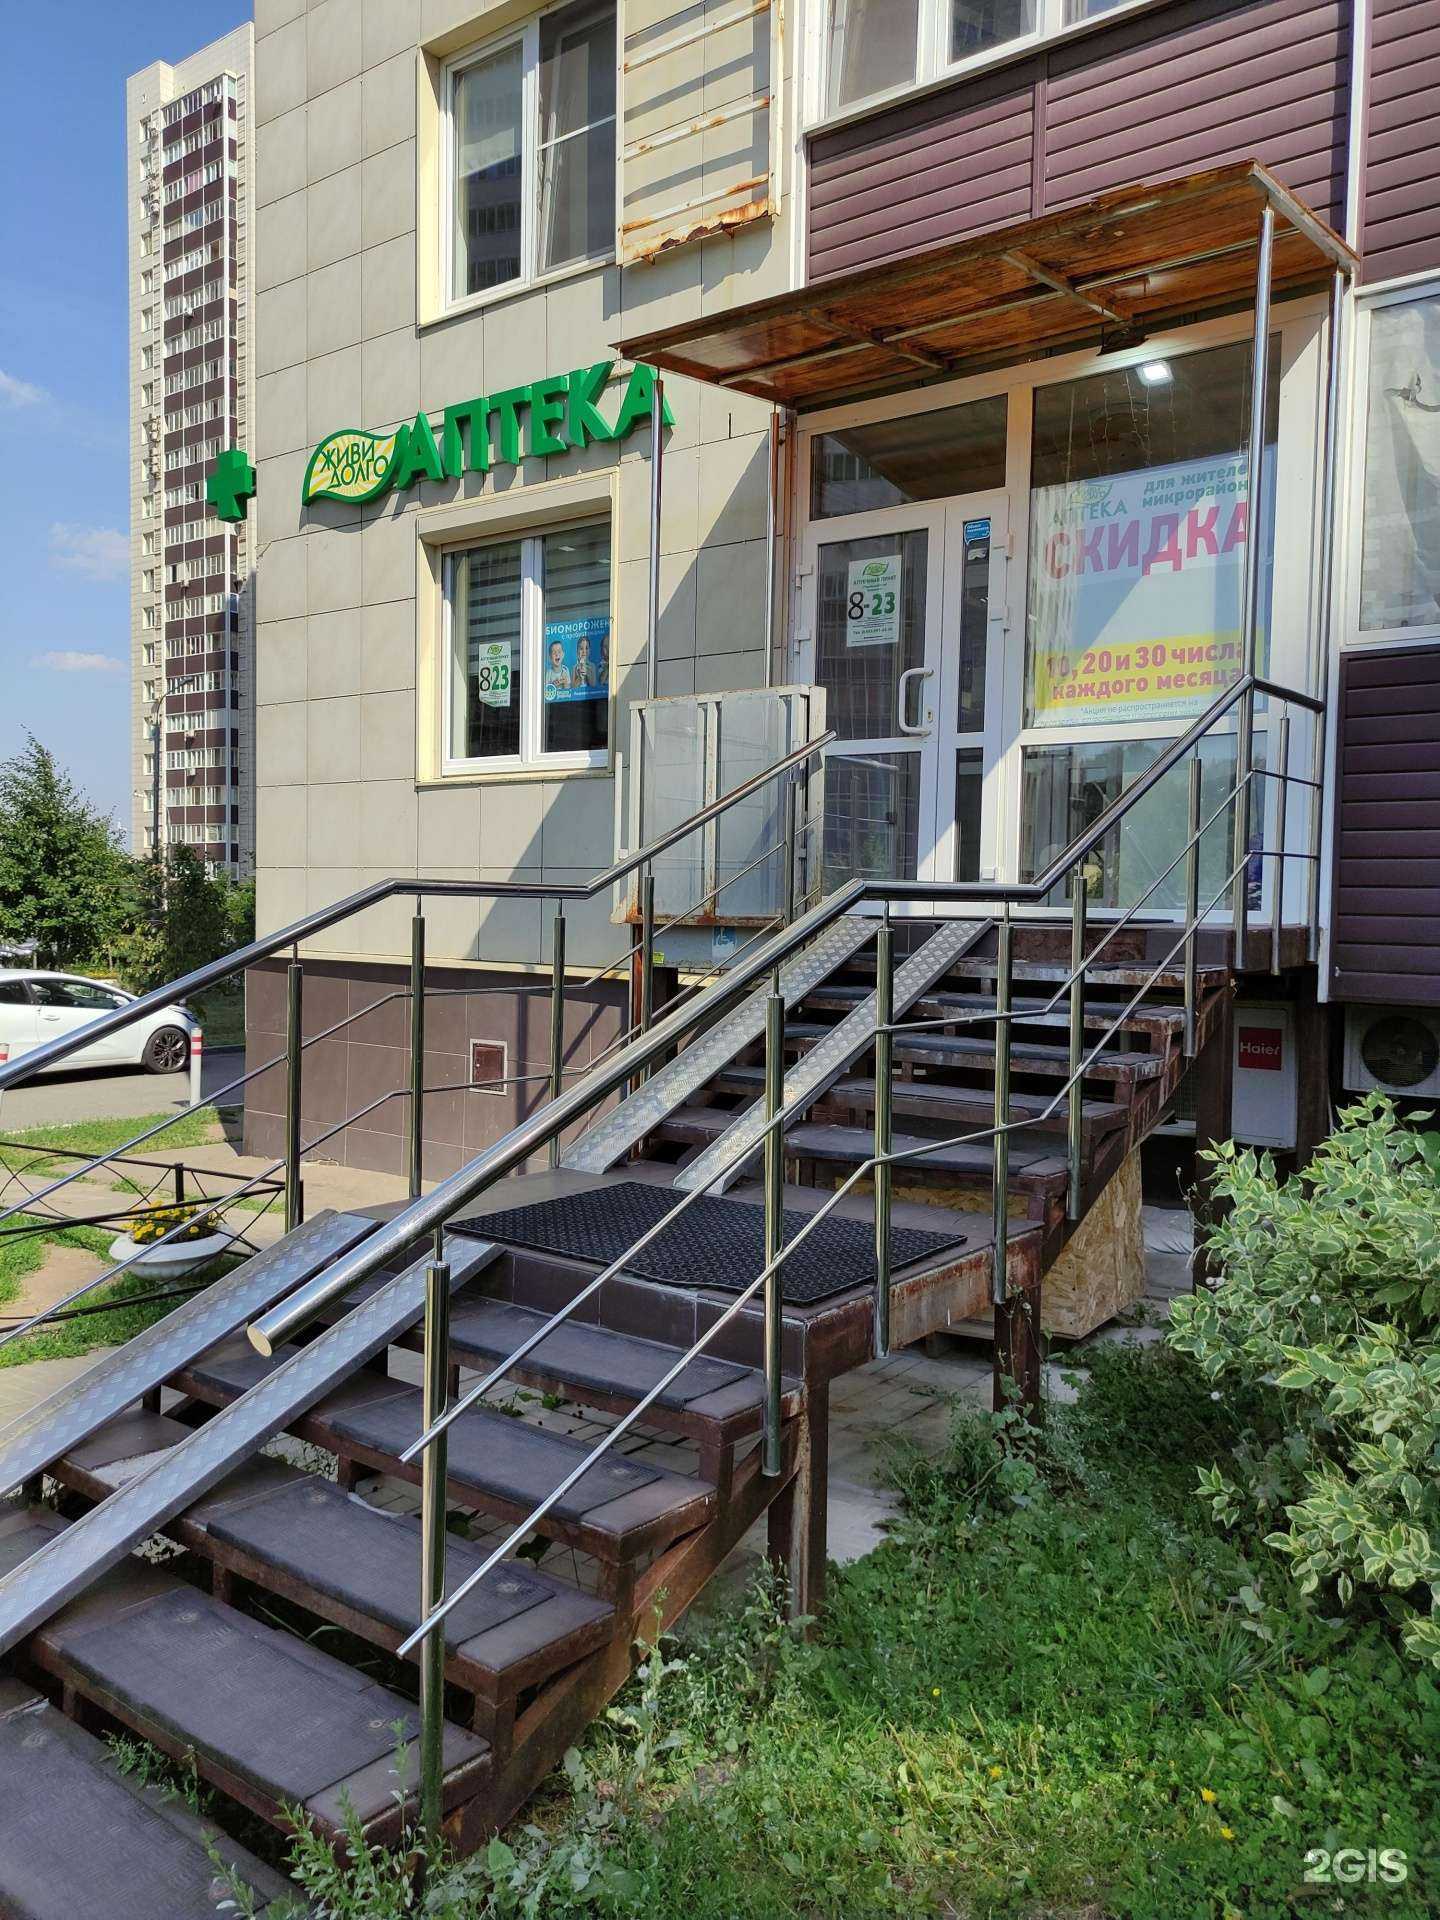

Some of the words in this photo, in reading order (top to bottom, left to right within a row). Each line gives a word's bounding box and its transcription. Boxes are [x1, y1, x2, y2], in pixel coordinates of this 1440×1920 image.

[395, 361, 675, 490] АПТЕКА
[320, 440, 374, 473] ЖИВИ
[327, 455, 389, 490] ДОЛГО
[1143, 477, 1175, 496] для
[1181, 464, 1248, 487] жителе
[1142, 479, 1248, 509] микрорайон
[1045, 501, 1248, 580] СКИДКА
[545, 619, 609, 635] БИОМОРОЖЕН
[1082, 650, 1112, 674] 20
[1115, 653, 1130, 670] и
[1135, 644, 1166, 669] 30
[1053, 676, 1149, 699] каждого
[1240, 1041, 1280, 1055] Haier
